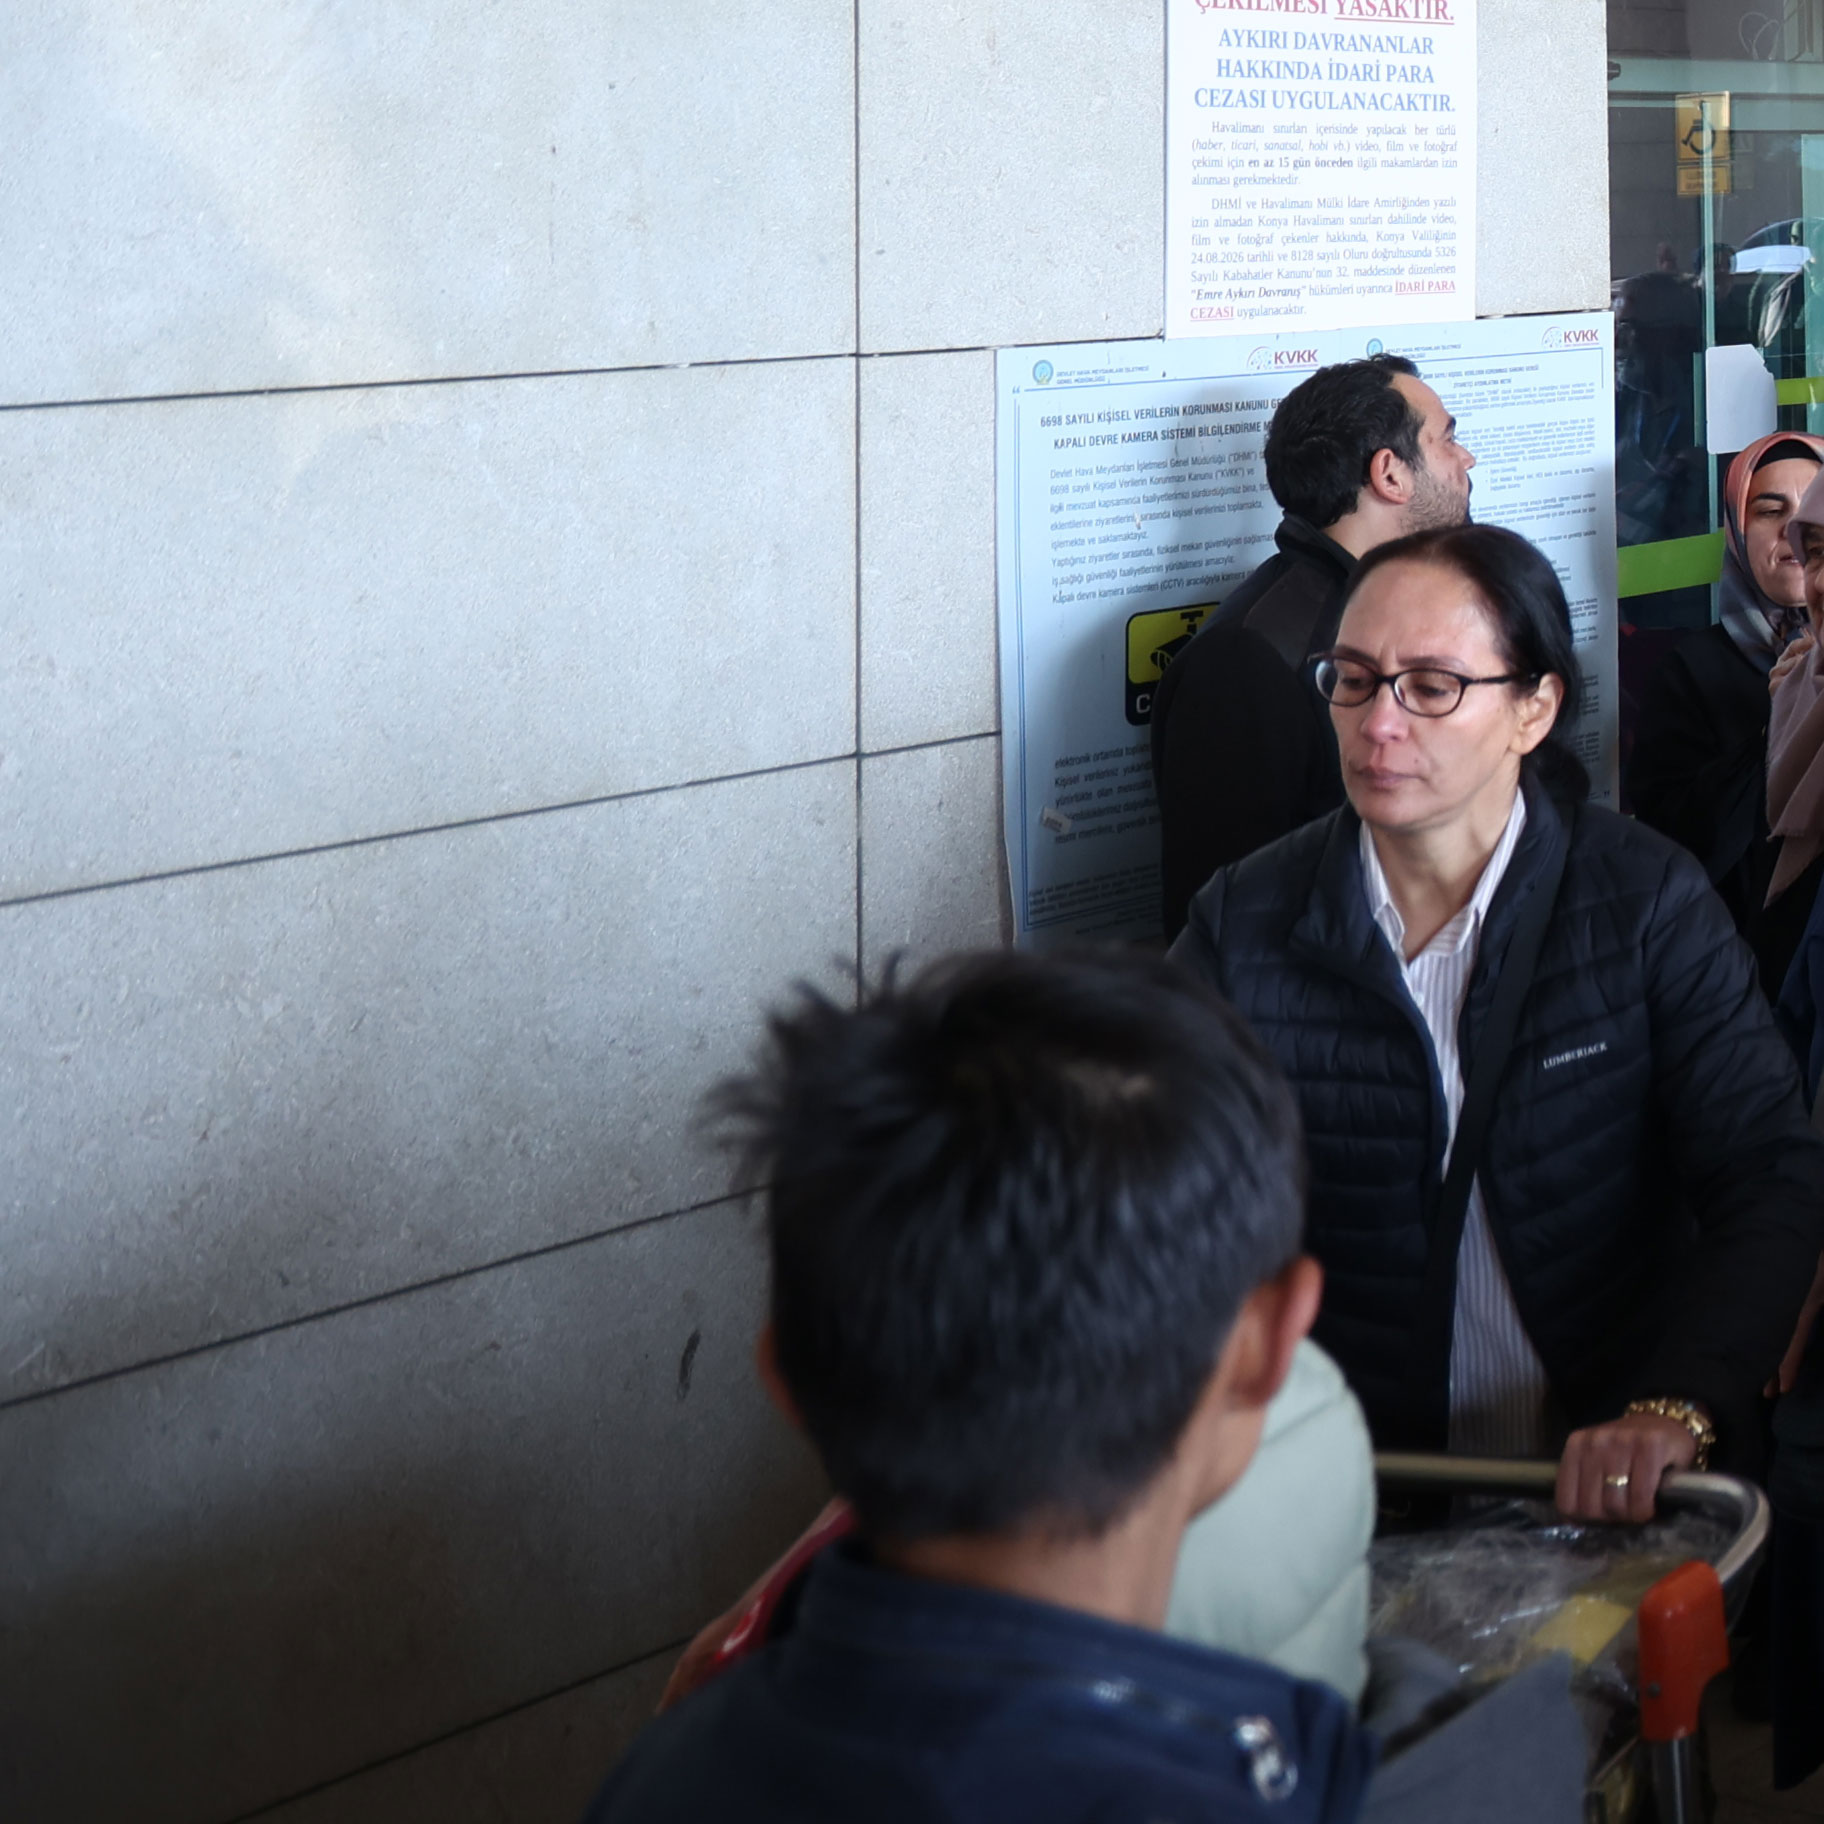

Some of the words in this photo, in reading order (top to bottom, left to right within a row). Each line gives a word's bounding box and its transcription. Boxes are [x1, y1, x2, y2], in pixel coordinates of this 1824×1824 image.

[1219, 28, 1287, 49] AYKIRI
[1294, 31, 1434, 54] DAVRANANLAR
[1216, 58, 1322, 80] HAKKINDA
[1328, 58, 1380, 82] İDARİ
[1386, 65, 1434, 83] PARA
[1195, 88, 1266, 108] CEZASI
[1273, 90, 1455, 112] UYGULANACAKTIR.
[1564, 329, 1599, 343] KVKK
[1275, 349, 1318, 364] KVKK
[1041, 416, 1063, 428] 6698
[1065, 413, 1094, 426] SAYILI
[1097, 410, 1131, 424] KİŞİSEL
[1135, 406, 1179, 421] VERİLERİN
[1183, 403, 1233, 416] KORUNMASI
[1235, 400, 1269, 412] KANUNU
[1054, 438, 1086, 449] KAPALI
[1089, 434, 1118, 446] DEVRE
[1122, 431, 1158, 443] KAMERA
[1162, 427, 1196, 440] SİSTEMİ
[1198, 422, 1261, 437] BİLGİLENDİRME
[1543, 1042, 1608, 1069] LUMBERJACK
